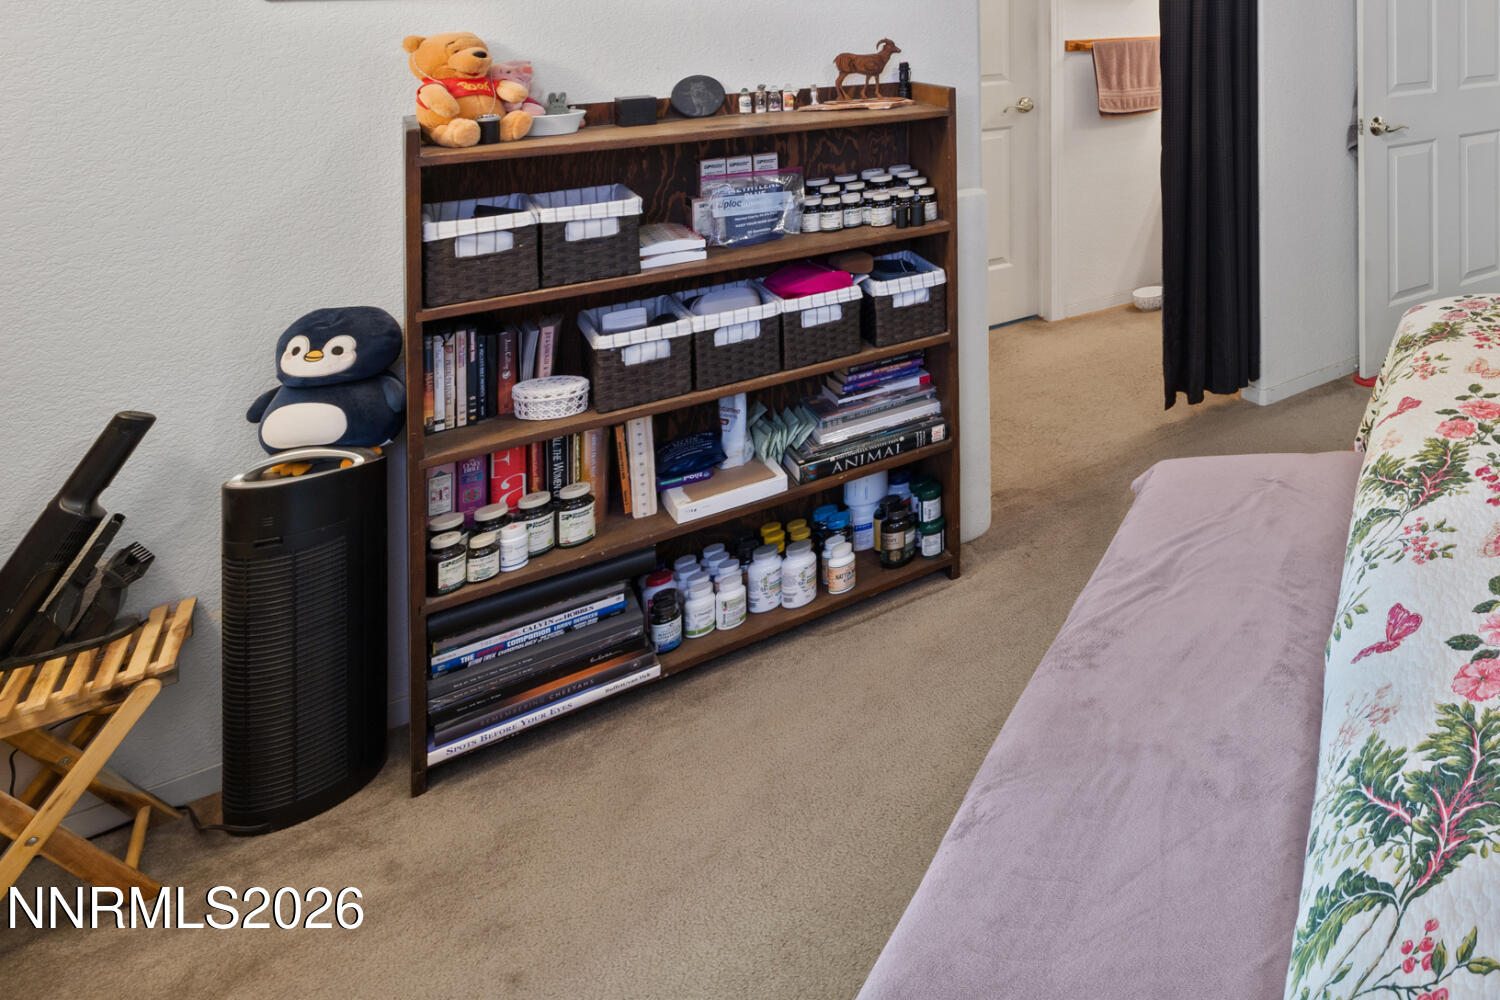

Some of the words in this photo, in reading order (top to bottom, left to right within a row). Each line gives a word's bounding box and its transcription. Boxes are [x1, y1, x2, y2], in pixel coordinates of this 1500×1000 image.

[552, 448, 562, 462] THE
[832, 444, 901, 474] ANIMAL
[522, 618, 555, 634] CALVIN
[563, 604, 595, 620] HOBBES
[460, 652, 475, 664] THE
[506, 626, 551, 648] COMPANION
[548, 678, 595, 700] CHEETAHS
[445, 738, 478, 756] SPOTS
[480, 724, 518, 743] BEFORE
[520, 712, 548, 726] YOUR
[549, 702, 574, 716] EYES
